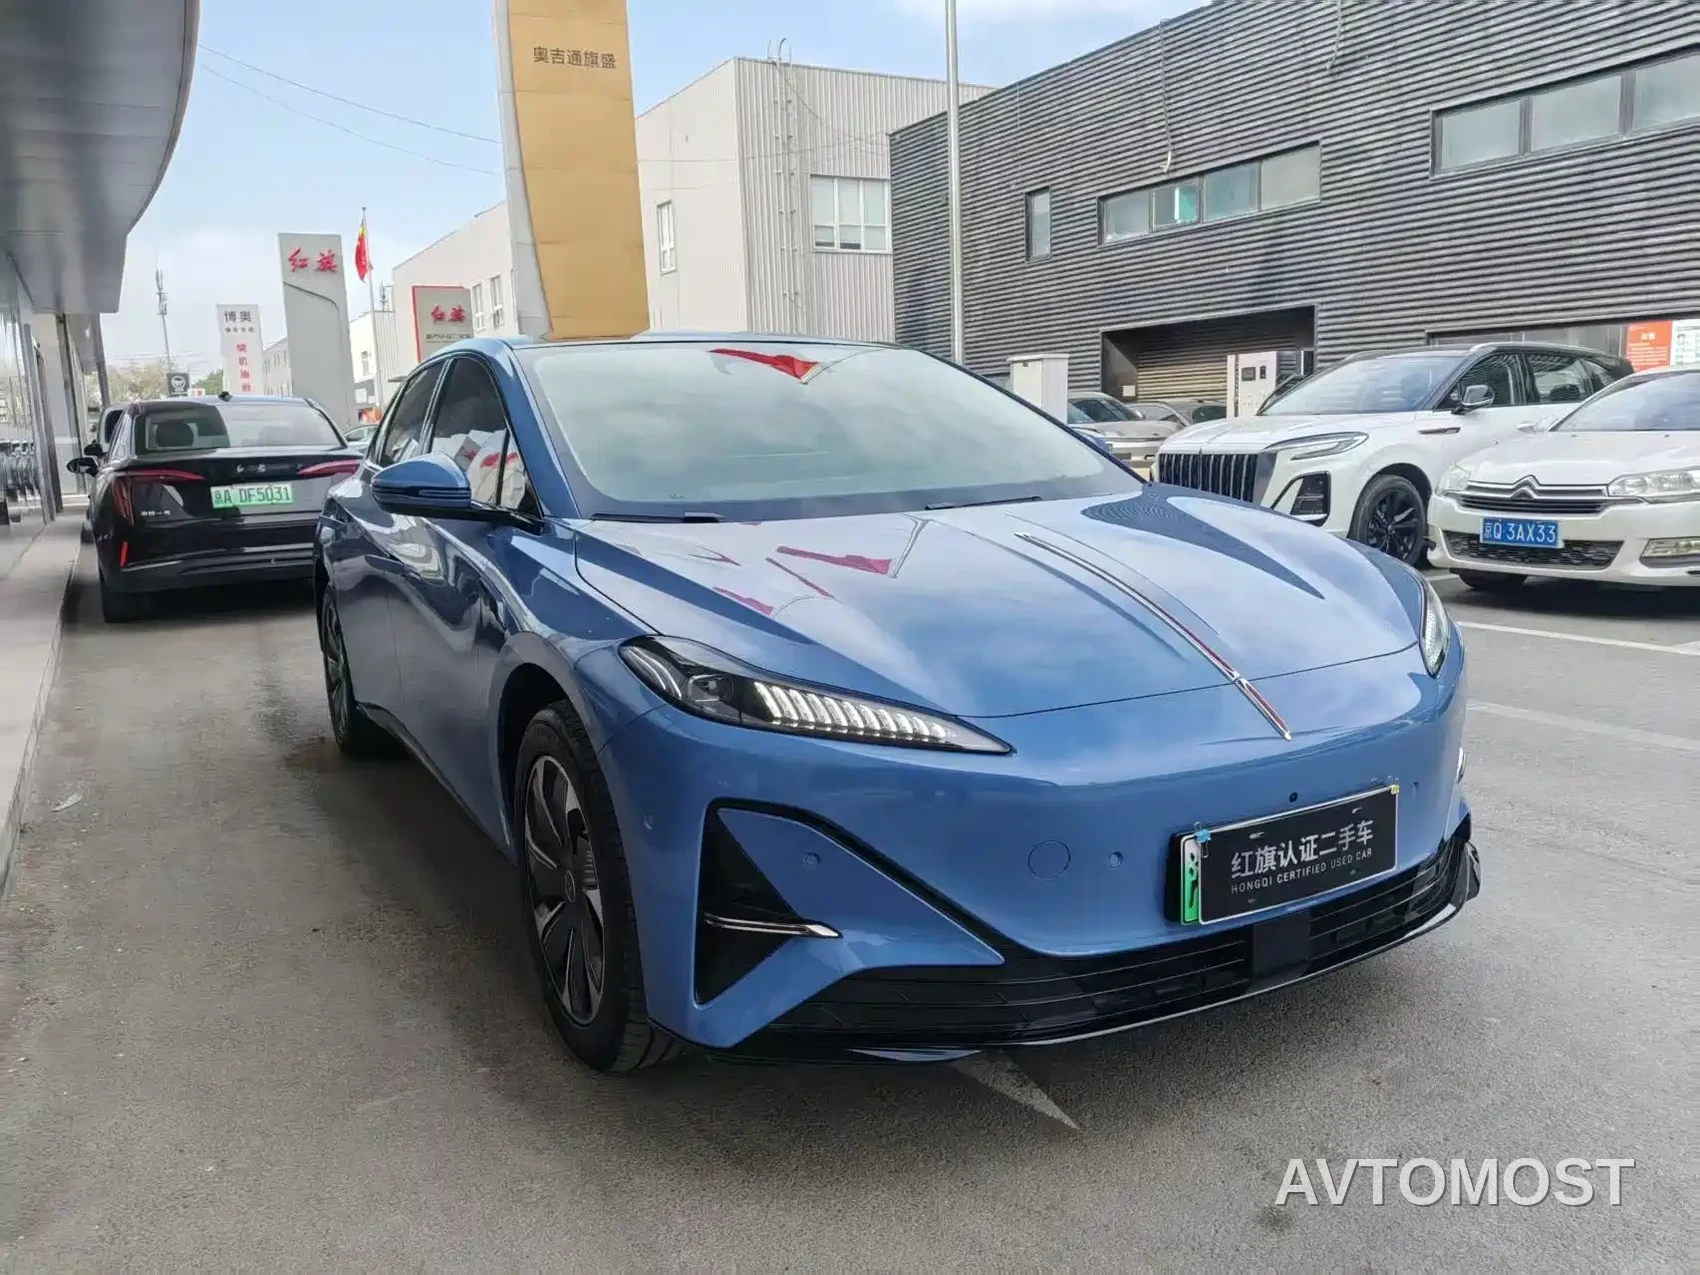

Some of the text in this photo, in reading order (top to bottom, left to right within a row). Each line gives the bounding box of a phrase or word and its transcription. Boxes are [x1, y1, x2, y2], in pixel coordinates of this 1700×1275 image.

[533, 46, 617, 69] 奥吉通旗盛
[287, 247, 338, 273] 红旗
[430, 304, 467, 324] 红旗
[1231, 819, 1374, 879] 红旗认证二手车
[1231, 847, 1373, 894] HONGQI CERTIFIED USED CAR
